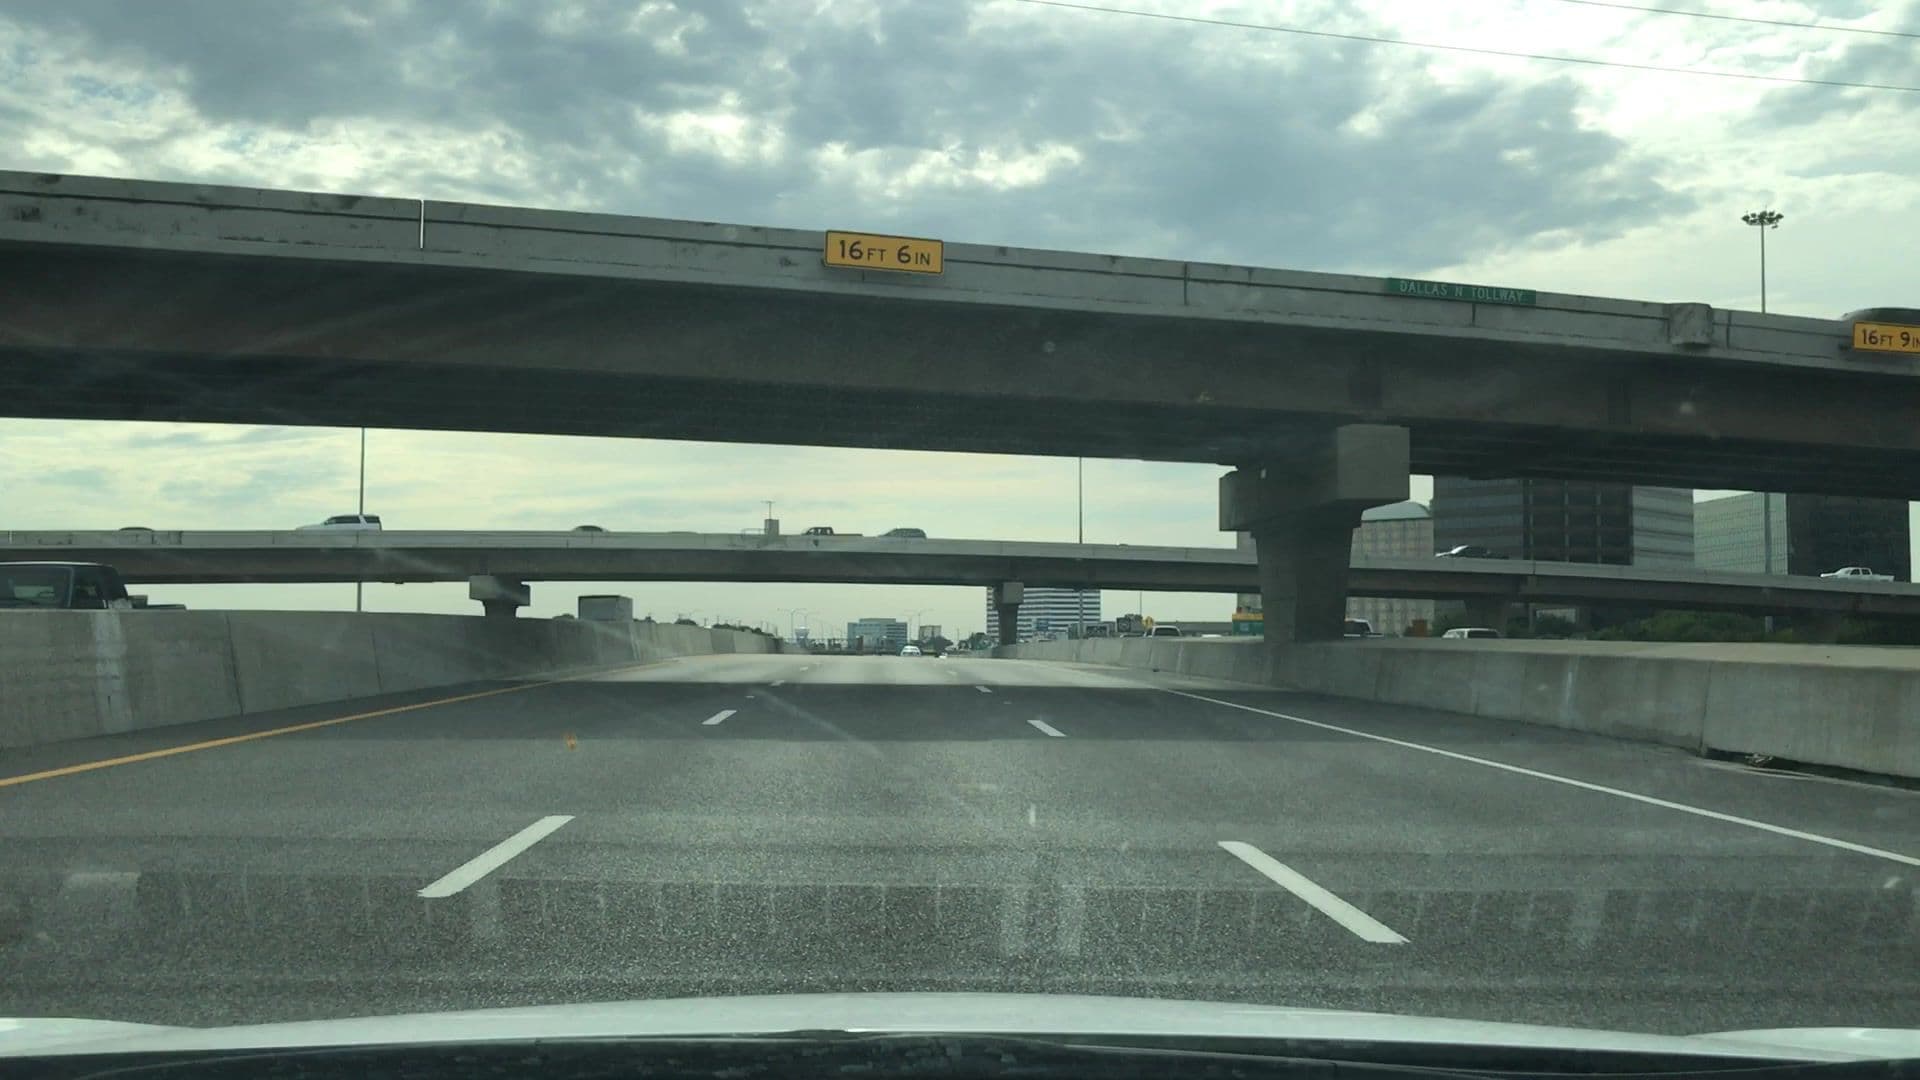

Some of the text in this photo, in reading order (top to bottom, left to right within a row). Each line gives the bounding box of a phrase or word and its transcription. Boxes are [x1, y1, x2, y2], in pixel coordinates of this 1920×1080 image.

[1400, 280, 1524, 303] DALLAS N TOLLWAY
